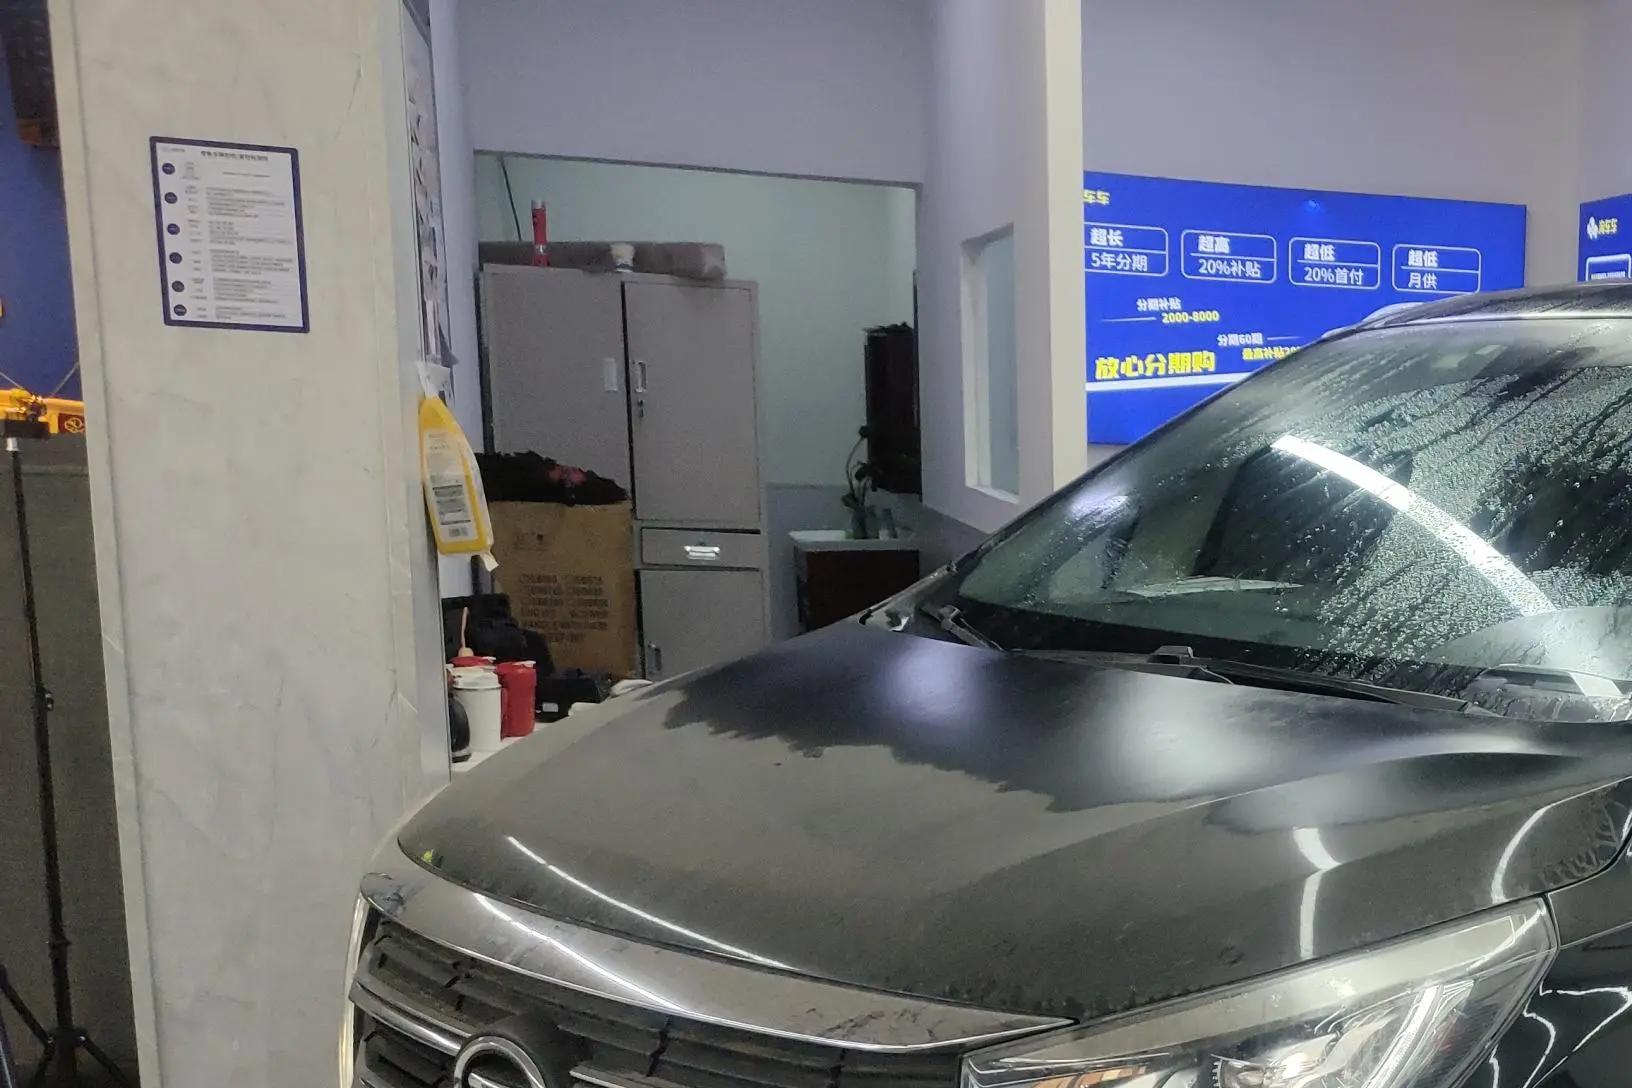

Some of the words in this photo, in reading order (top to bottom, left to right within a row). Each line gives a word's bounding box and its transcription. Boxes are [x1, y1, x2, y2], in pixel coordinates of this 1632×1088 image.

[1090, 227, 1124, 247] 超长
[1198, 235, 1230, 254] 超高
[1091, 252, 1148, 271] 5年分期
[1303, 243, 1336, 261] 超低
[1408, 248, 1438, 268] 超低
[1198, 258, 1262, 278] 20%补贴
[1304, 266, 1364, 285] 20%首付
[1408, 272, 1438, 290] 月供
[1136, 296, 1182, 312] 分期补贴
[1161, 310, 1220, 324] 2000-8000
[1217, 332, 1263, 347] 分期60期
[1095, 350, 1216, 380] 放心分期购
